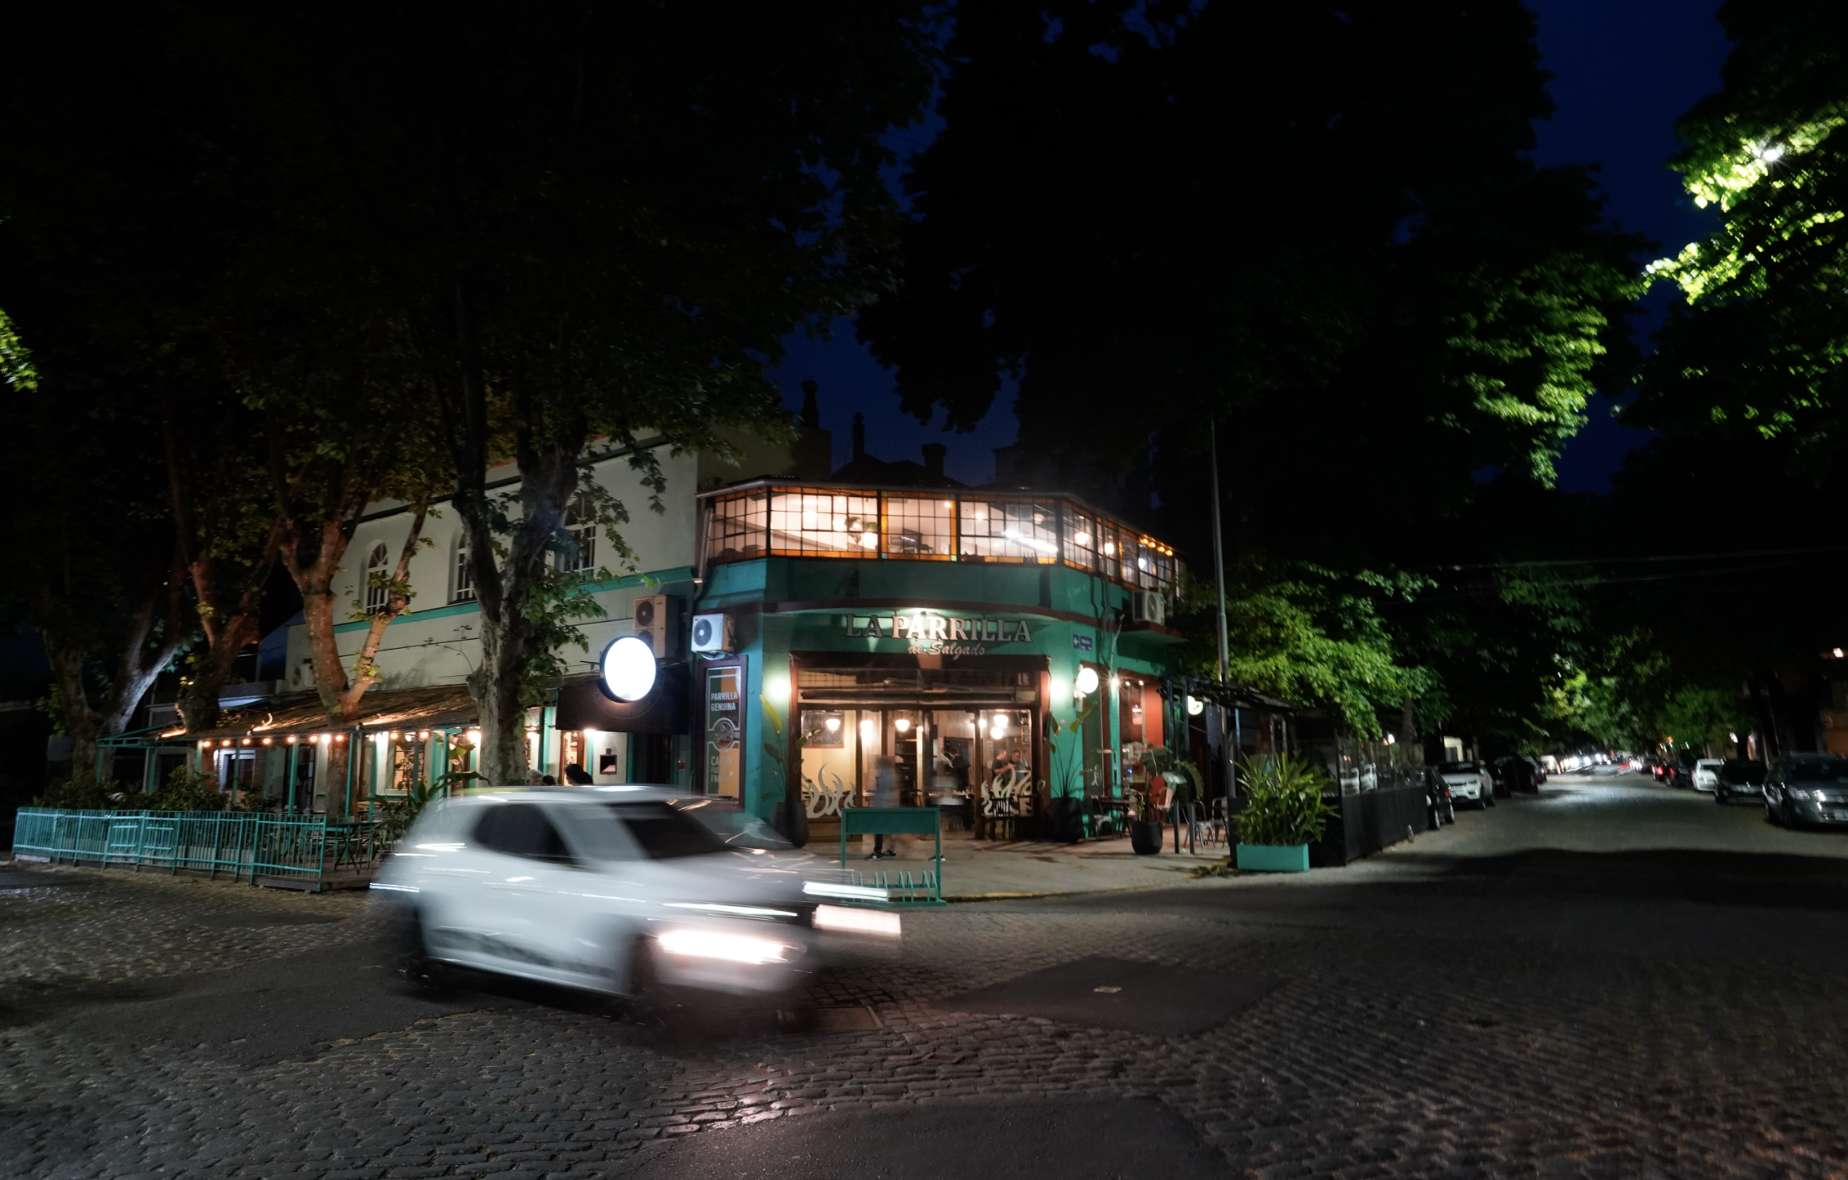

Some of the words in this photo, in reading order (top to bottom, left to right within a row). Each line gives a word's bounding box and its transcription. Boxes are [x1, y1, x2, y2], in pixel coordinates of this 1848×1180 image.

[845, 614, 883, 638] LA
[892, 614, 1032, 642] PARRILLA
[908, 644, 924, 655] de
[926, 641, 986, 661] Salgado
[710, 691, 738, 701] PARRILLA
[710, 702, 737, 711] GENUINA
